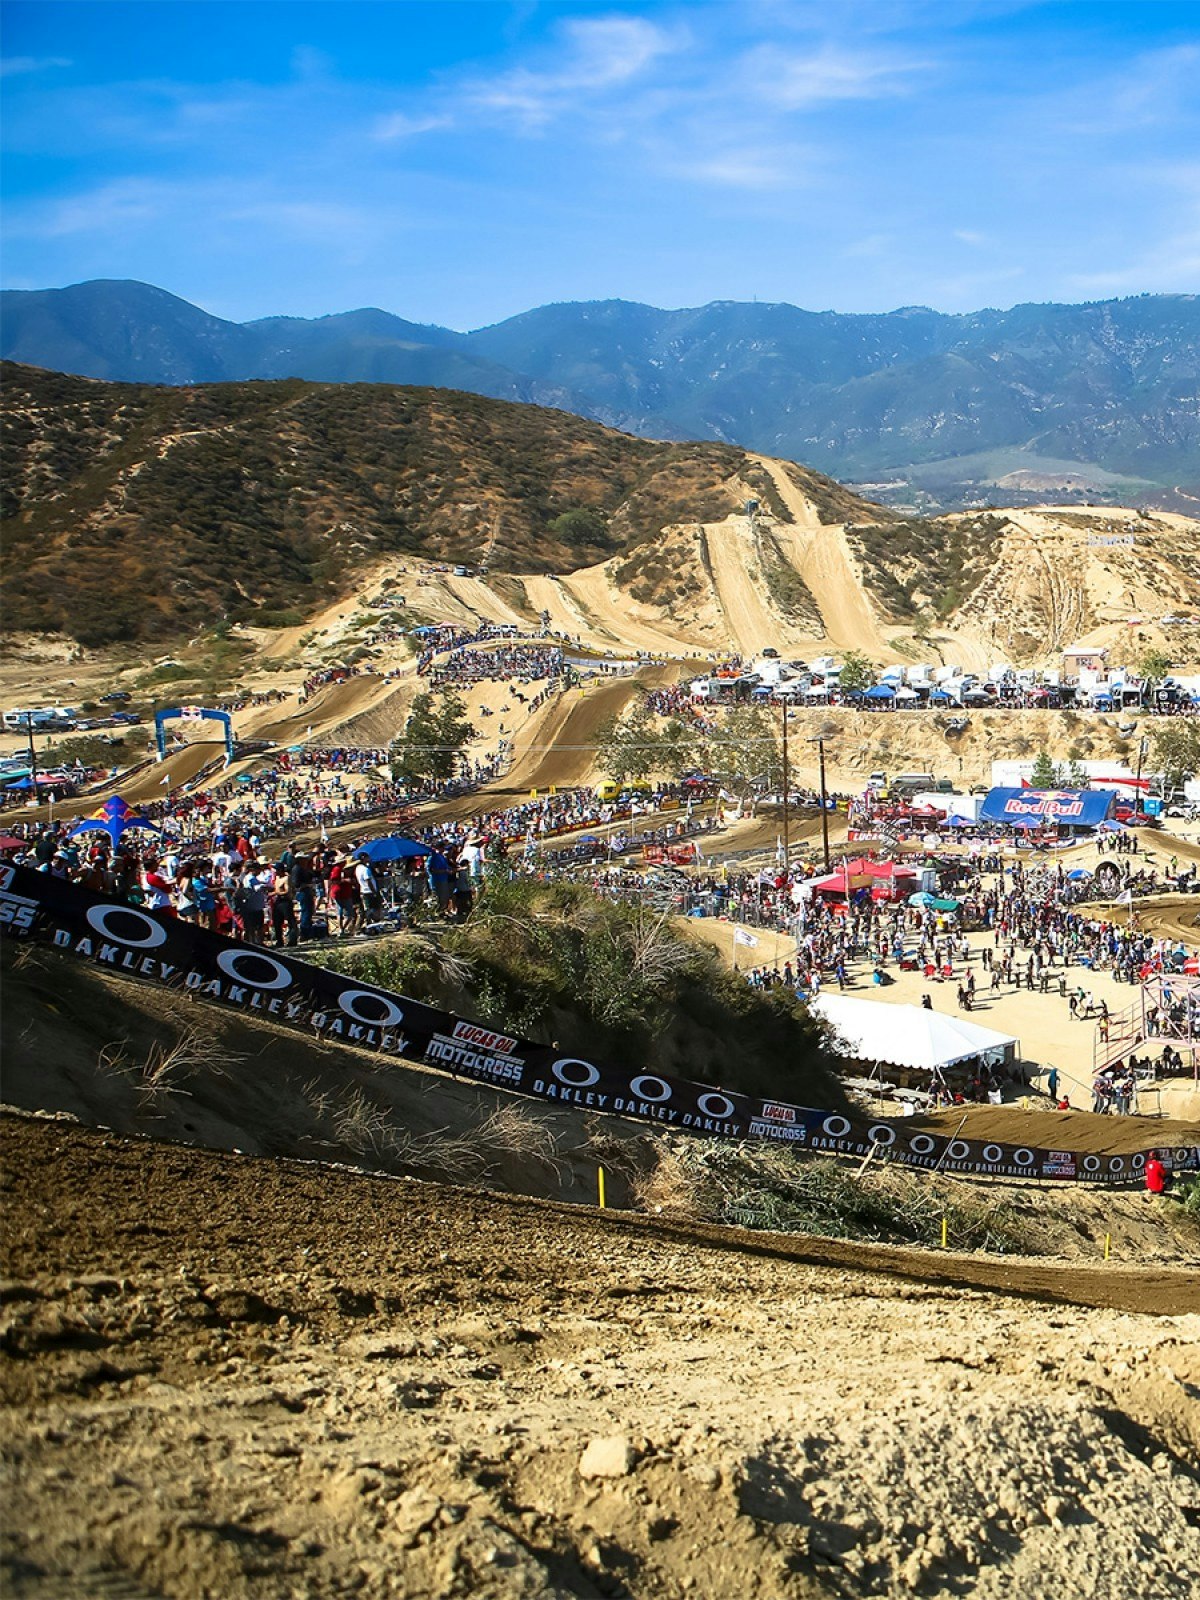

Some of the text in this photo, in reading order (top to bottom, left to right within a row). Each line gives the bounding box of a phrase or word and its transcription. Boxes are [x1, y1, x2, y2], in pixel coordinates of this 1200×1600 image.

[1004, 799, 1084, 816] Red Bull
[53, 928, 175, 980] OAKLEY
[185, 971, 301, 1018] OAKLEY
[310, 1011, 410, 1052] OAKLEY
[455, 1024, 515, 1053] LUCAS OIL
[425, 1039, 524, 1081] MOTOCROSS
[533, 1079, 608, 1107] OAKLEY
[614, 1097, 679, 1121] OAKLEY
[682, 1114, 740, 1136] OAKLEY
[749, 1122, 806, 1141] MOTOCROSS
[811, 1137, 853, 1150] OAKLEY
[899, 1151, 936, 1167] OAKLEY
[1007, 1164, 1038, 1176] OAKLEY
